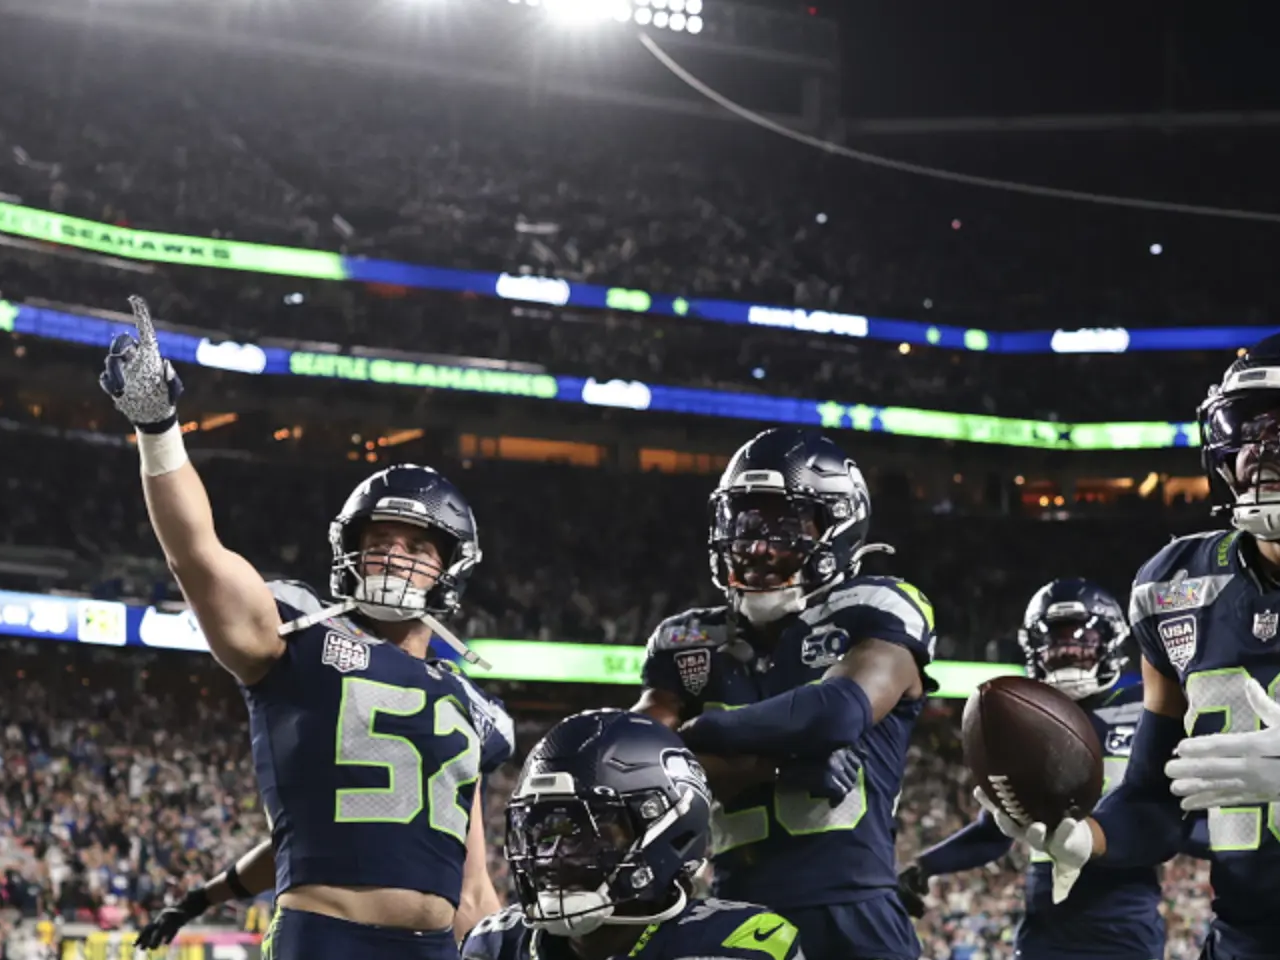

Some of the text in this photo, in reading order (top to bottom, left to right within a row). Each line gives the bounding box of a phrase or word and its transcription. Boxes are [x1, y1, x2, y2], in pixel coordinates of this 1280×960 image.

[61, 223, 231, 260] SEAHAWKS
[1162, 621, 1193, 639] USA
[677, 655, 706, 669] USA
[334, 677, 480, 843] 52
